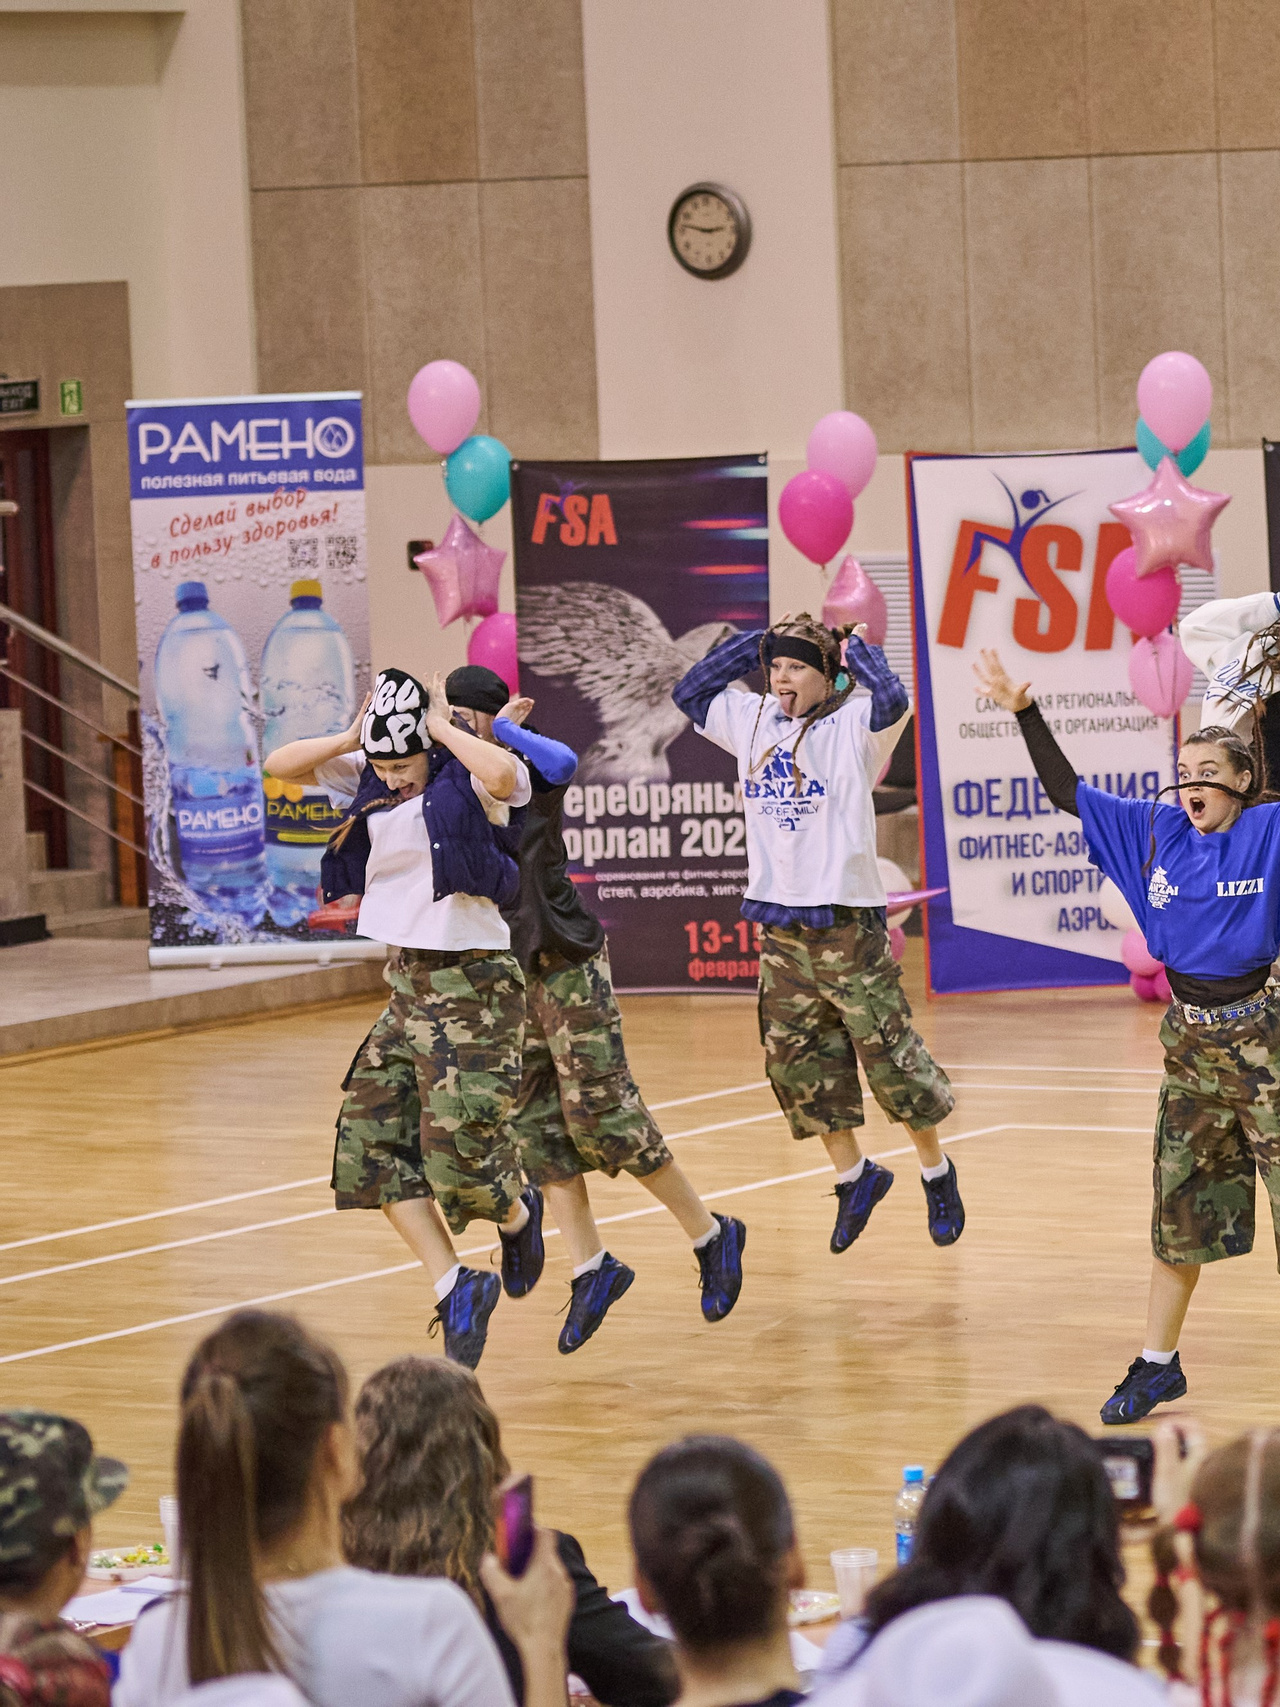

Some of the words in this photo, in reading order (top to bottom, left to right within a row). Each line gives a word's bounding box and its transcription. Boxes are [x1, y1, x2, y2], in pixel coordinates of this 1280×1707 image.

[138, 417, 355, 465] РАМЕНО
[141, 472, 224, 490] полезная
[228, 470, 310, 486] питьевая
[314, 467, 357, 484] вода
[169, 502, 237, 538] Сделай
[246, 487, 308, 518] выбор
[531, 493, 618, 546] FSA
[151, 555, 160, 569] в
[169, 533, 234, 564] пользу
[242, 502, 340, 546] здоровья!
[1056, 691, 1142, 710] РЕГИОНАЛЬН
[959, 718, 1061, 739] ОБЩЕСТВЯ
[1065, 716, 1159, 734] ОРГАНИЗАЦИЯ
[563, 776, 745, 824] еребряны
[953, 772, 1160, 820] ФЕДЕИЯ
[178, 802, 261, 830] РАМЕНО
[562, 825, 671, 867] орлан
[680, 817, 747, 858] 202
[681, 868, 749, 881] фитнес-аэроб
[1012, 872, 1026, 896] И
[1216, 877, 1265, 897] LIZZI
[640, 882, 709, 900] аэробика,
[712, 884, 748, 897] хип-х
[1058, 906, 1118, 932] АЭРО
[688, 957, 760, 981] феврал
